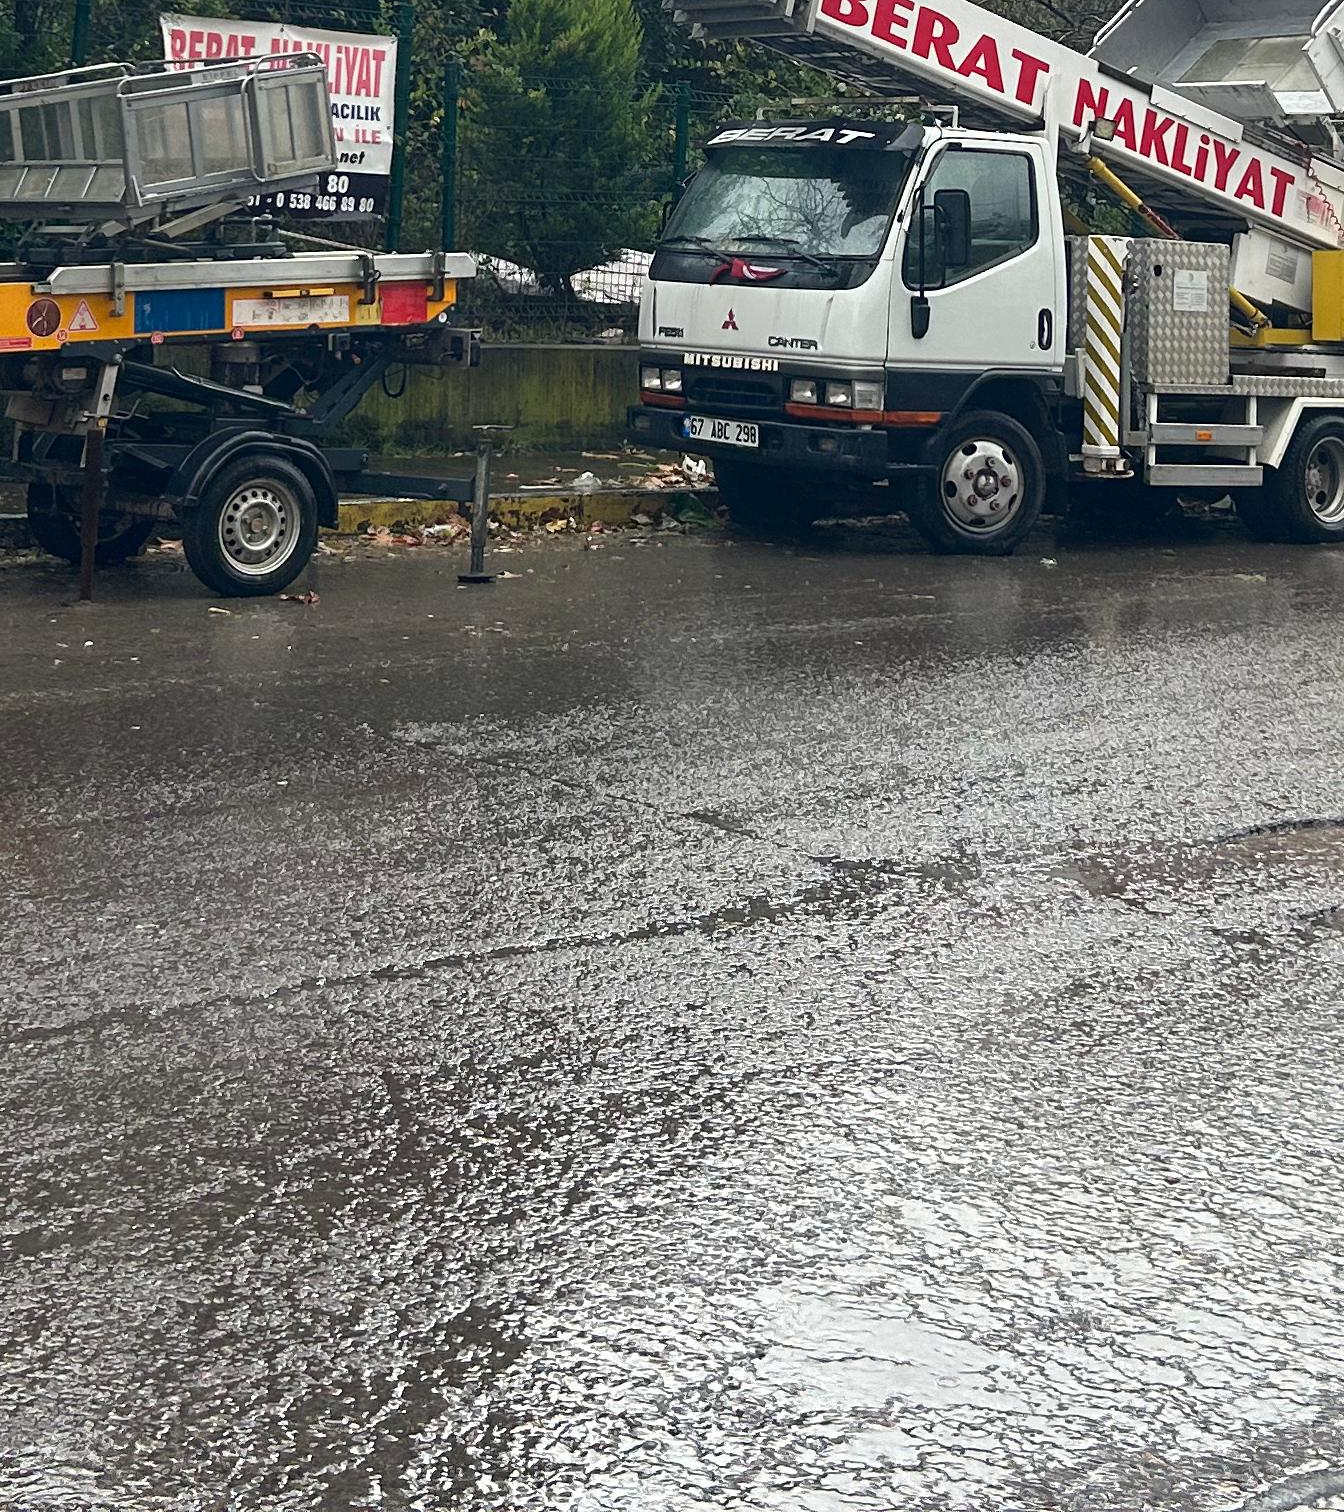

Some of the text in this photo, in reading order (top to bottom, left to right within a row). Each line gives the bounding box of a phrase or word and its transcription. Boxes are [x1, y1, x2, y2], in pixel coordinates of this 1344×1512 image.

[706, 126, 876, 145] BERAT
[276, 193, 285, 207] 0
[289, 193, 311, 210] 538
[315, 194, 337, 211] 466
[340, 196, 355, 212] 89
[358, 197, 374, 213] 80
[768, 336, 818, 351] CANTER
[683, 352, 780, 372] MITSUBISHI
[690, 417, 757, 444] 67 ABC 298
